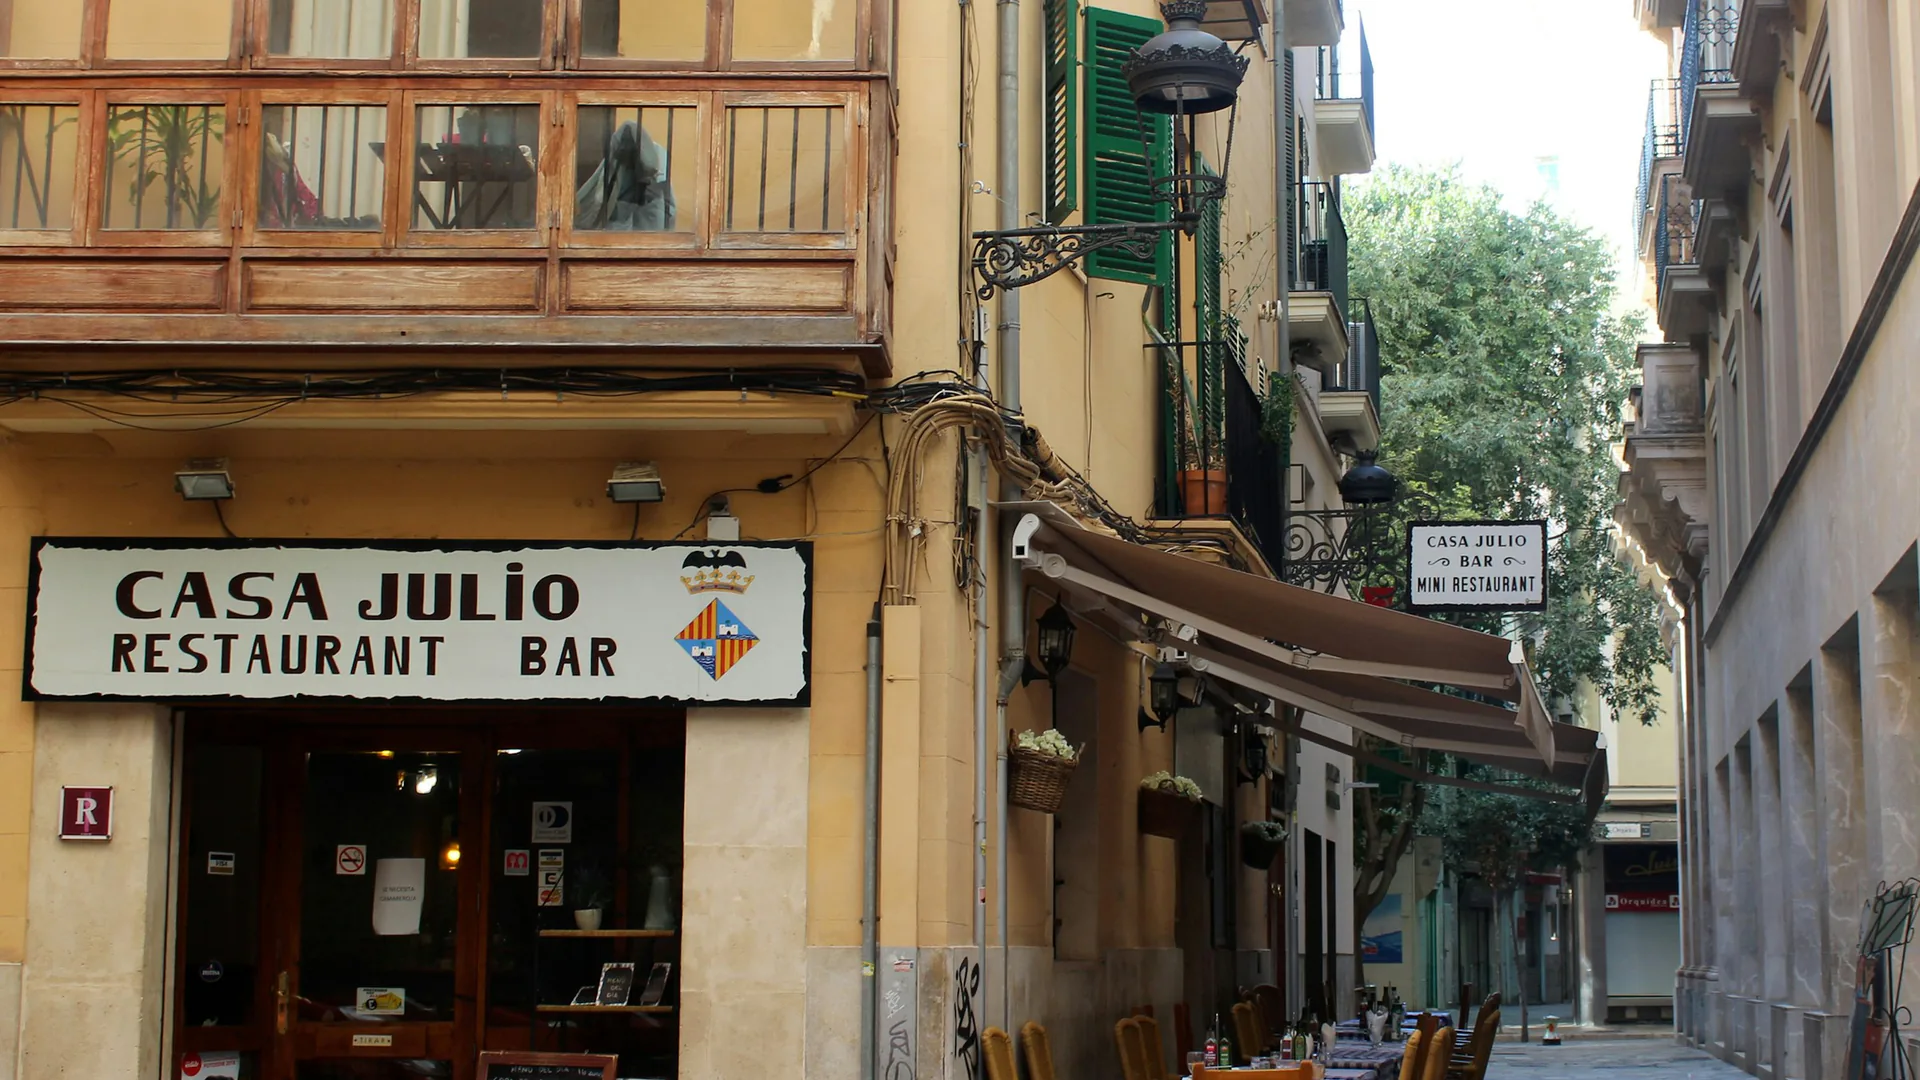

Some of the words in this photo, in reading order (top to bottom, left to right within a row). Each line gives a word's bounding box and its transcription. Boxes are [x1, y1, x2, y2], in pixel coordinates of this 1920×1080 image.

[1427, 535, 1469, 548] CASA
[1475, 534, 1527, 547] JULIO
[1460, 555, 1493, 567] BAR
[1417, 577, 1446, 593] MINI
[1452, 576, 1536, 593] RESTAURANT
[116, 571, 329, 621] CASA
[112, 633, 445, 676] RESTAURANT
[520, 636, 618, 677] BAR
[75, 797, 98, 825] R
[359, 1036, 385, 1044] TIRAR
